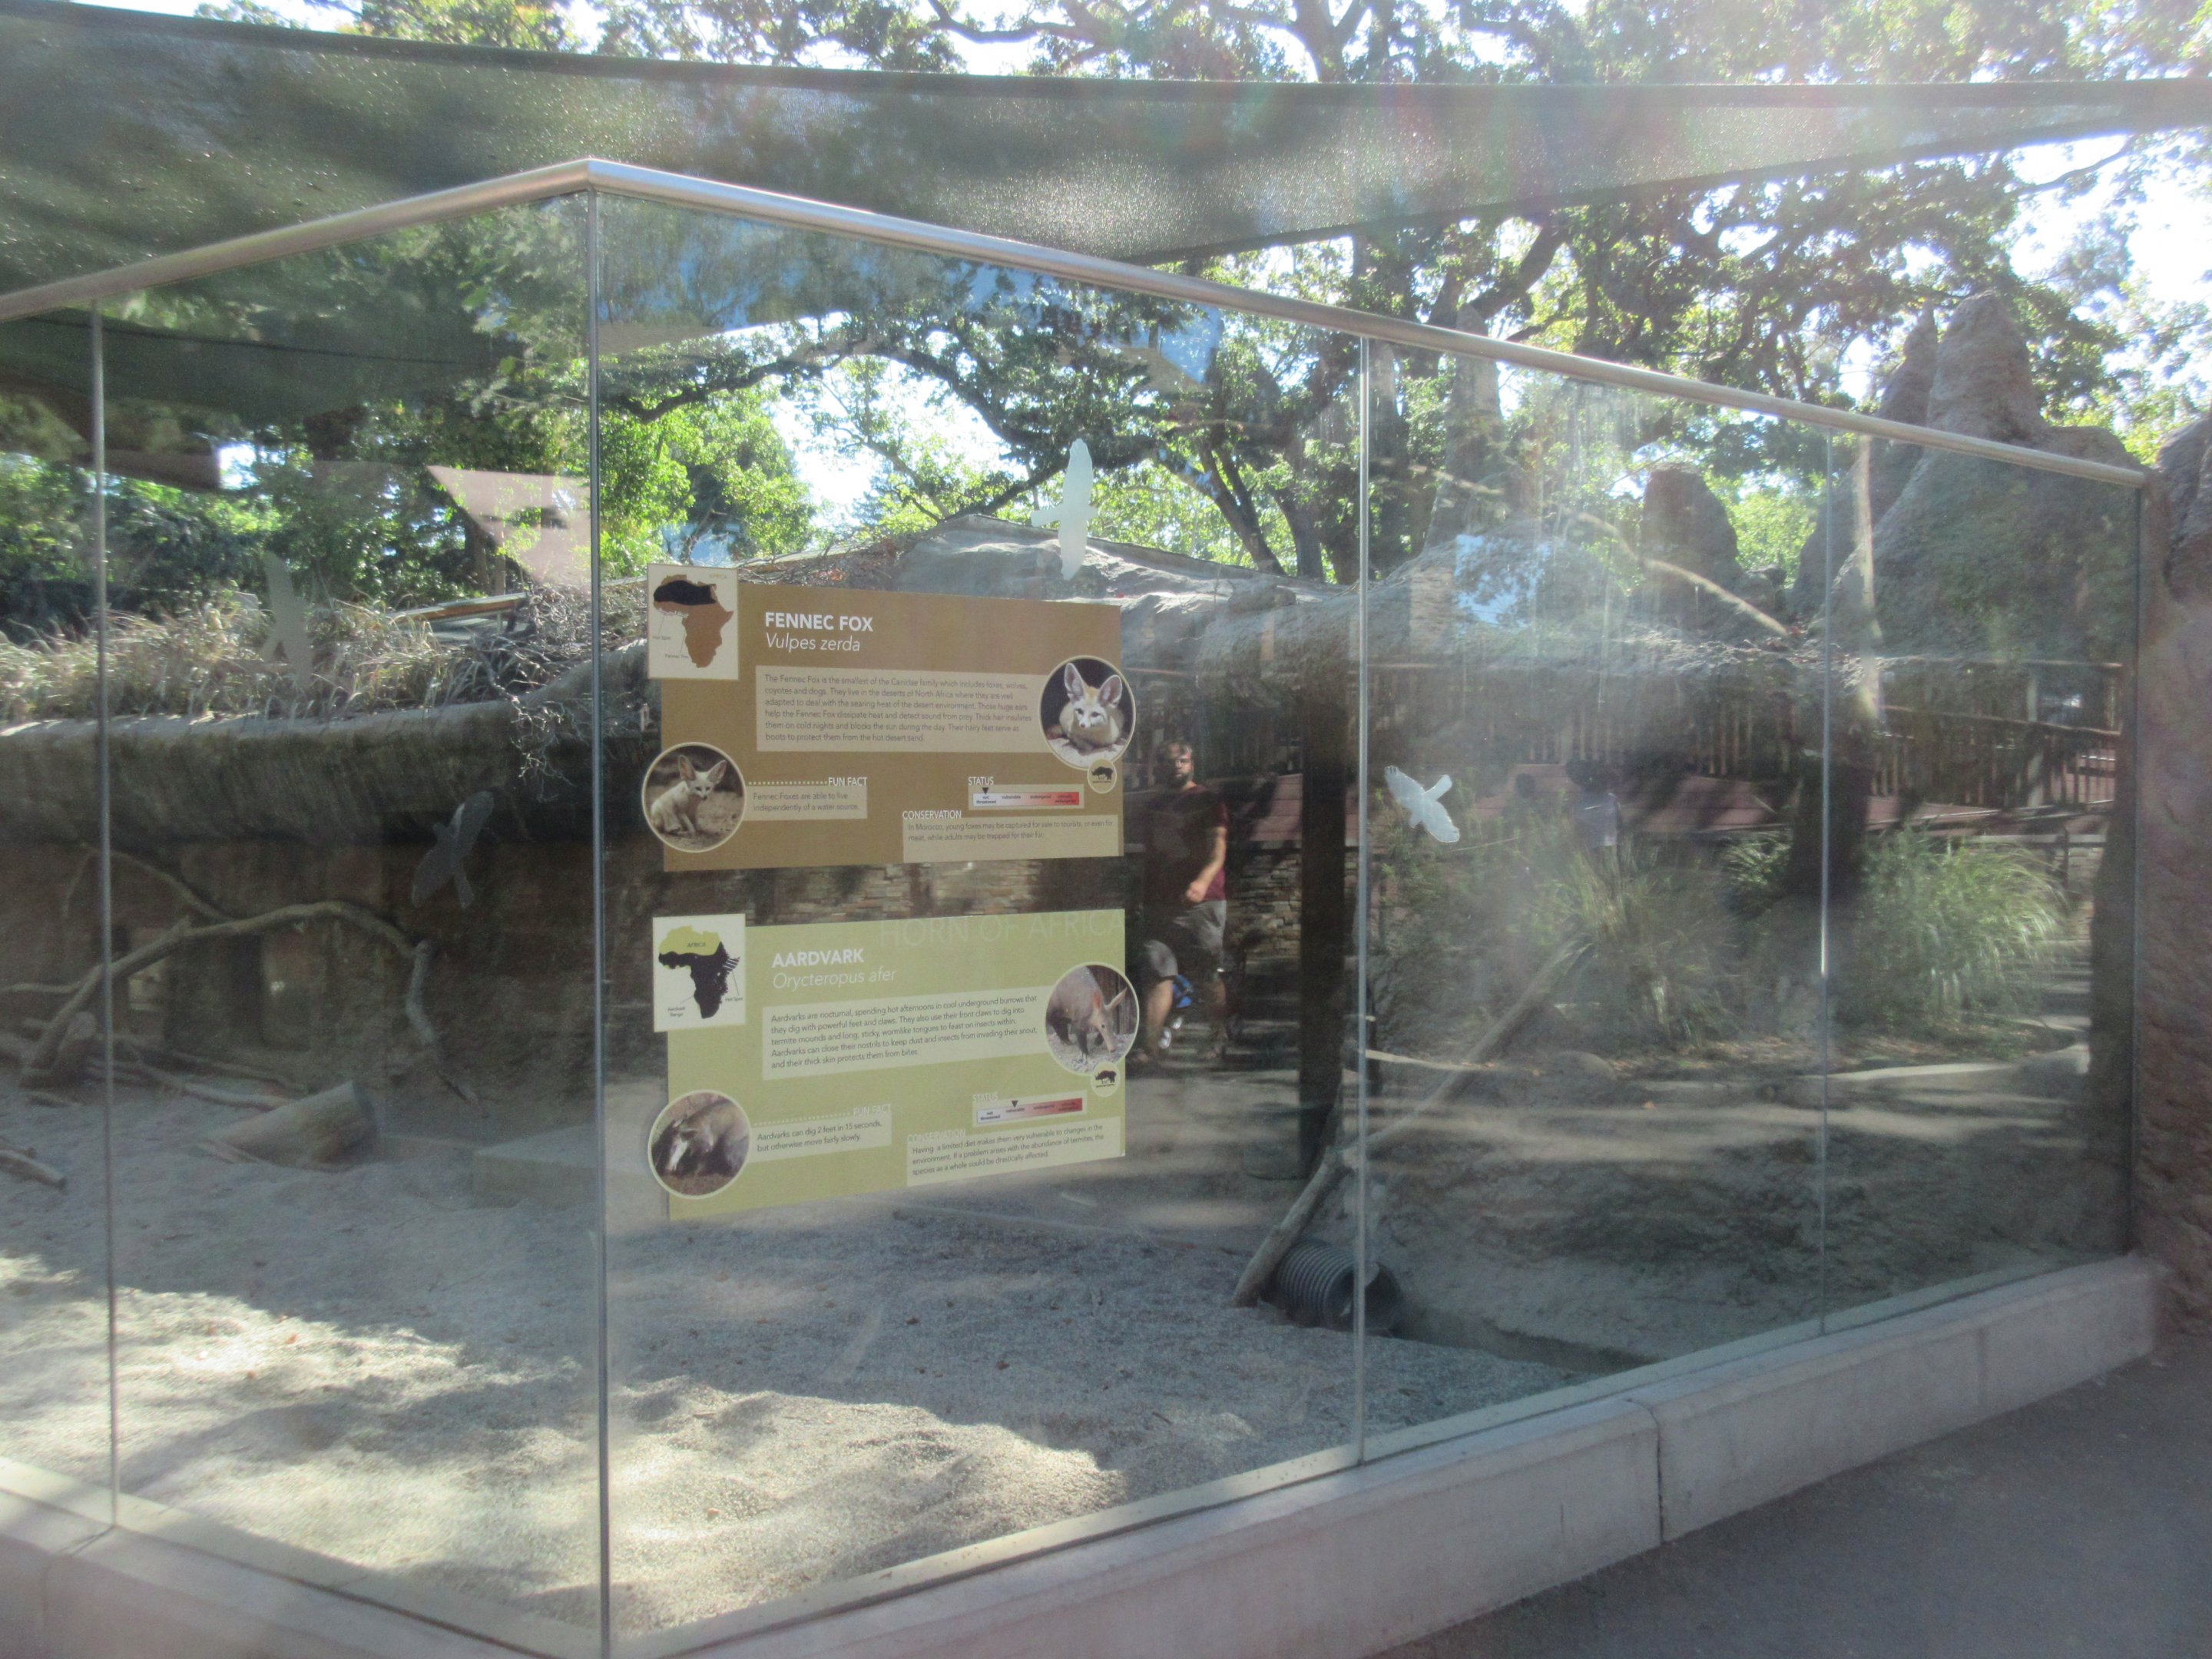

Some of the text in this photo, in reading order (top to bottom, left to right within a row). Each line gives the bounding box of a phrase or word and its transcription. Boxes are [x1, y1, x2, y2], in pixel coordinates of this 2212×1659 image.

[766, 612, 873, 631] FENNEC FOX
[767, 633, 860, 653] Vulpes zerda
[828, 777, 867, 786] FUN FACT
[968, 777, 994, 785] STATUS
[902, 810, 962, 820] CONSERVATION
[880, 910, 1124, 945] HORN OF AFRICA
[772, 949, 864, 968] AARDVARK
[773, 965, 897, 992] Orycteropus afer
[771, 1013, 806, 1022] Aardvarks
[855, 1006, 886, 1018] spending
[899, 1003, 934, 1012] afternoons
[943, 1001, 957, 1009] cool
[958, 998, 998, 1009] underground
[1000, 995, 1024, 1005] burrows
[772, 1025, 787, 1035] they
[789, 1025, 800, 1034] dig
[801, 1023, 816, 1031] with
[817, 1021, 847, 1031] powerful
[849, 1019, 863, 1028] feet
[900, 1015, 915, 1025] They
[916, 1014, 929, 1022] also
[943, 1012, 958, 1020] their
[959, 1011, 974, 1019] front
[975, 1009, 992, 1018] claws
[1002, 1008, 1012, 1017] dig
[1013, 1006, 1025, 1015] into
[772, 1036, 797, 1045] termite
[798, 1033, 826, 1043] mounds
[828, 1032, 841, 1041] and
[882, 1027, 912, 1036] wormlike
[912, 1024, 939, 1035] tongues
[949, 1022, 964, 1030] feast
[975, 1019, 995, 1028] insects
[772, 1047, 806, 1057] Aardvarks
[821, 1044, 839, 1052] close
[840, 1042, 856, 1051] their
[857, 1040, 881, 1049] nostrils
[891, 1038, 907, 1048] keep
[909, 1036, 923, 1045] dust
[924, 1035, 936, 1043] and
[938, 1033, 959, 1042] insects
[961, 1031, 975, 1040] from
[977, 1029, 1003, 1040] invading
[1004, 1028, 1018, 1036] their
[772, 1049, 900, 1068] and their thick skin protects them from
[853, 1104, 891, 1116] FUN FACT
[805, 1127, 816, 1137] dig
[837, 1124, 843, 1132] in
[845, 1123, 853, 1131] 15
[758, 1143, 770, 1151] but
